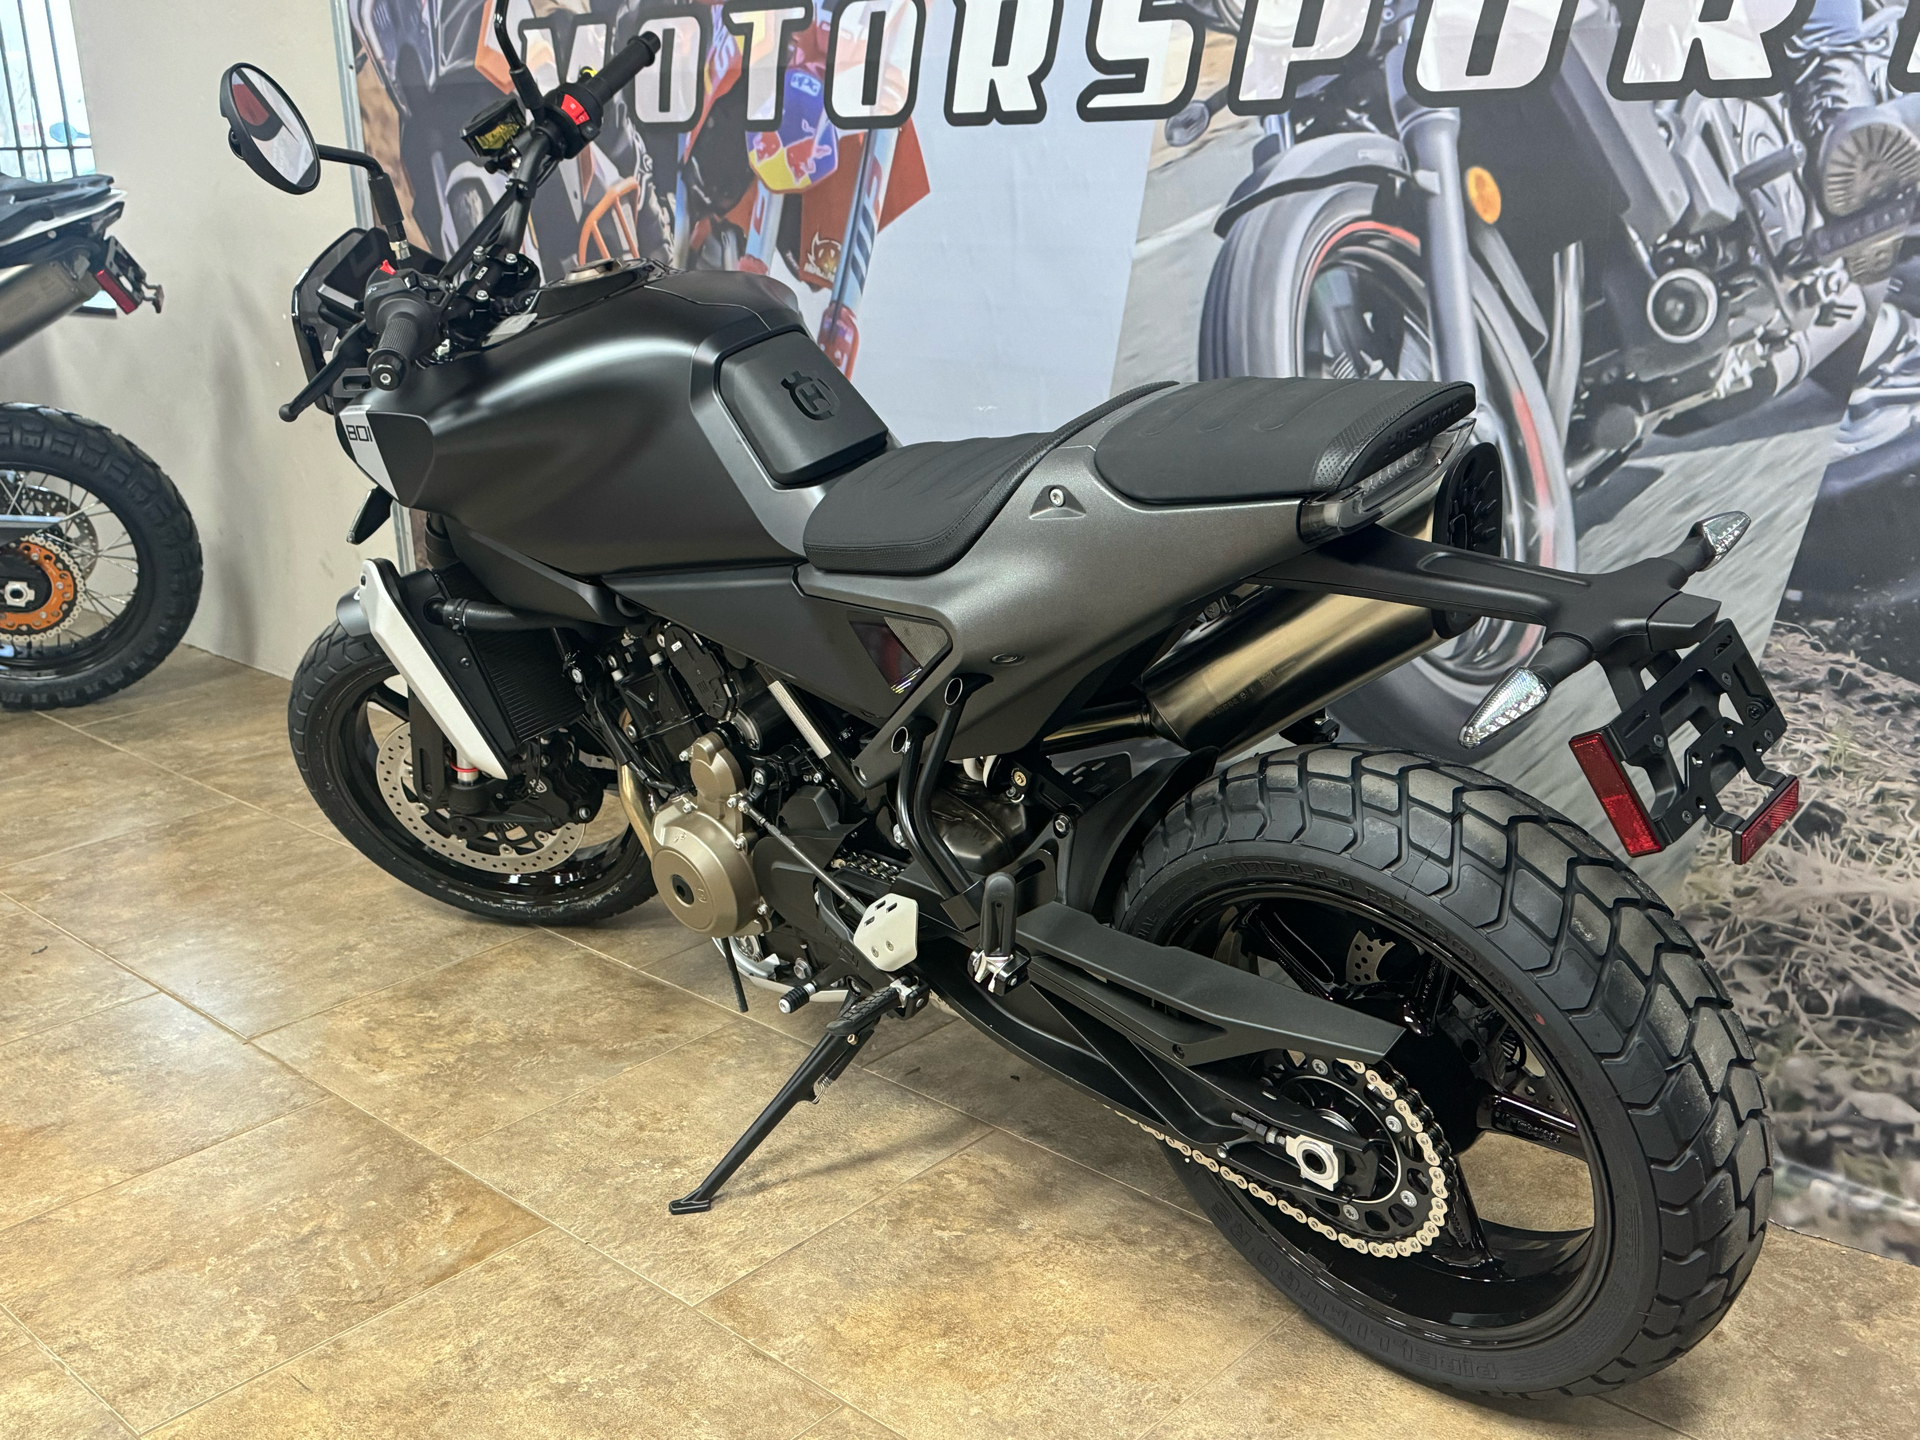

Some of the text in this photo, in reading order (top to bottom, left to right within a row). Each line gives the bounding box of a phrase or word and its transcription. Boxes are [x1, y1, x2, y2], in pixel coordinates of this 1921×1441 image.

[517, 0, 1921, 130] MOTORSPOR
[345, 424, 373, 442] 801
[1210, 860, 1354, 892] PIRELLI
[1357, 1320, 1498, 1380] PIRELLI
